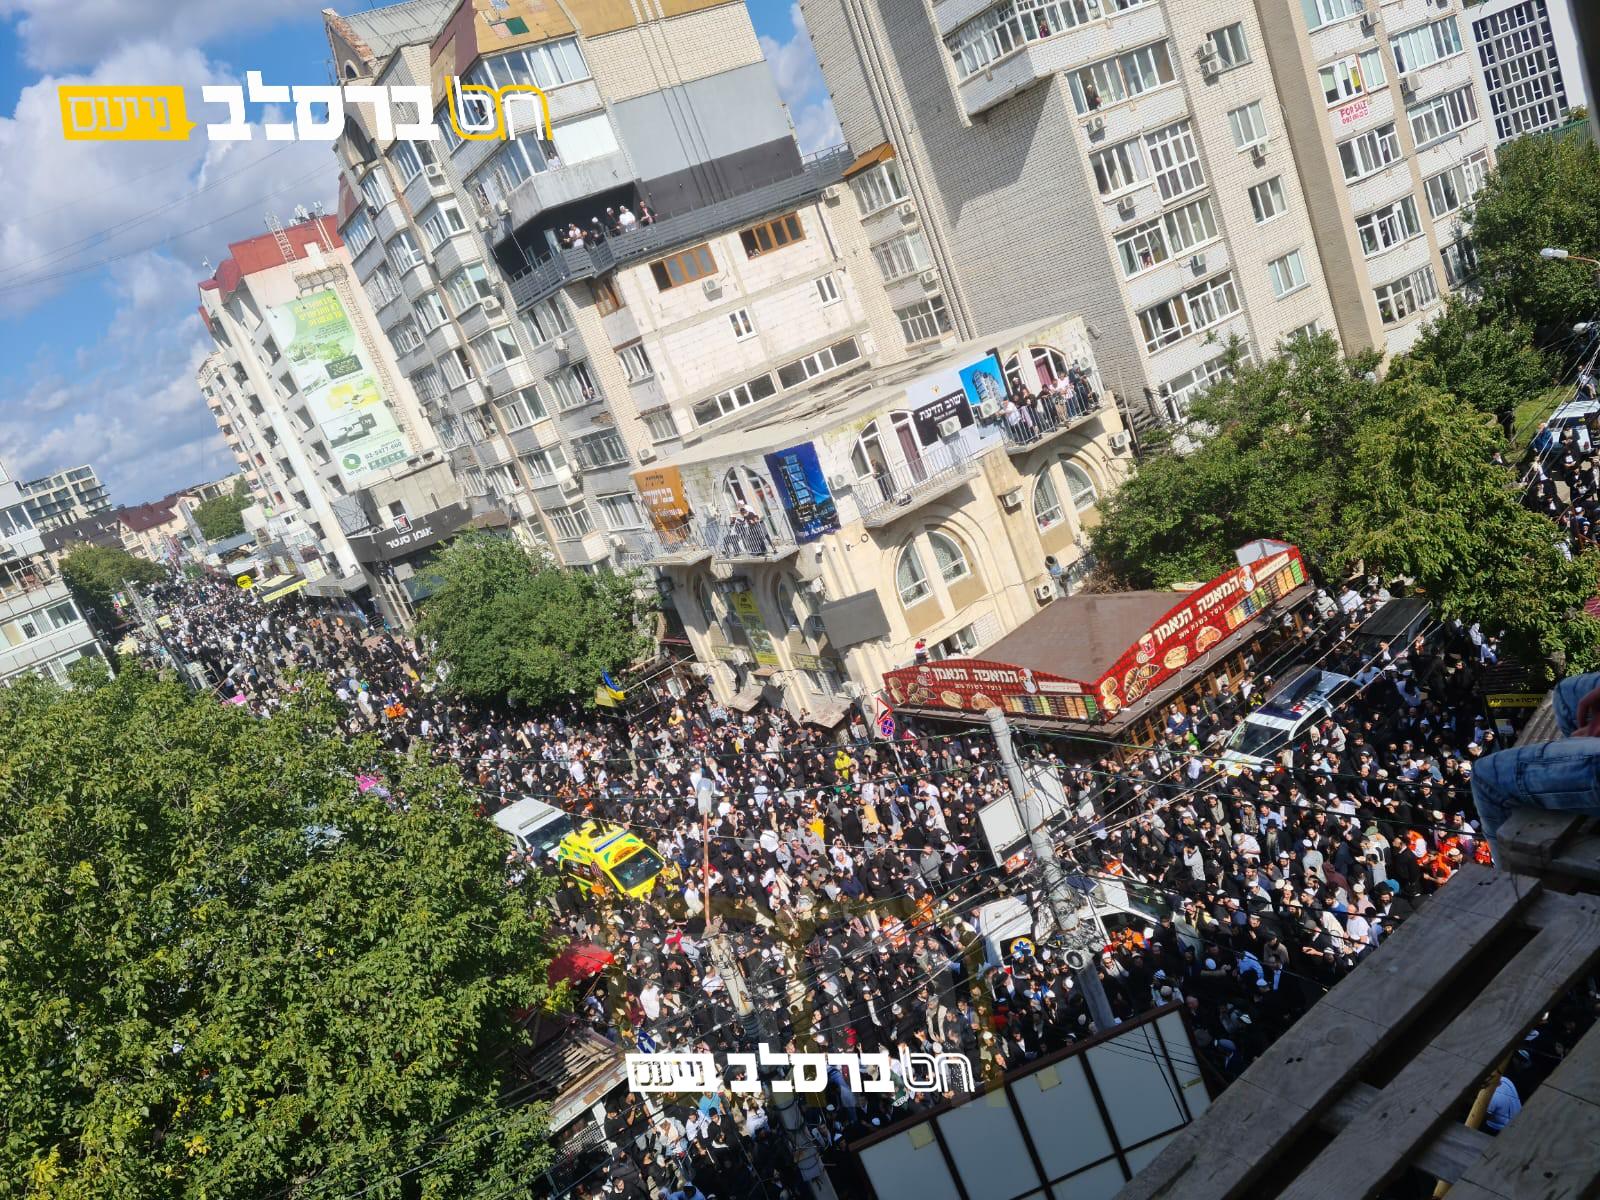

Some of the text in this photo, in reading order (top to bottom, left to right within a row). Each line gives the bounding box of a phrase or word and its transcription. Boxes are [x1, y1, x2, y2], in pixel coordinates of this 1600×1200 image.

[1341, 106, 1354, 118] FOR
[1354, 101, 1367, 112] SALE
[945, 393, 965, 409] ישוב
[919, 403, 945, 421] הדעת
[386, 534, 411, 549] סנטר
[412, 527, 434, 541] אומן
[1153, 576, 1240, 645] המאפה הנאמן
[931, 667, 1019, 684] המאפה הנאמן
